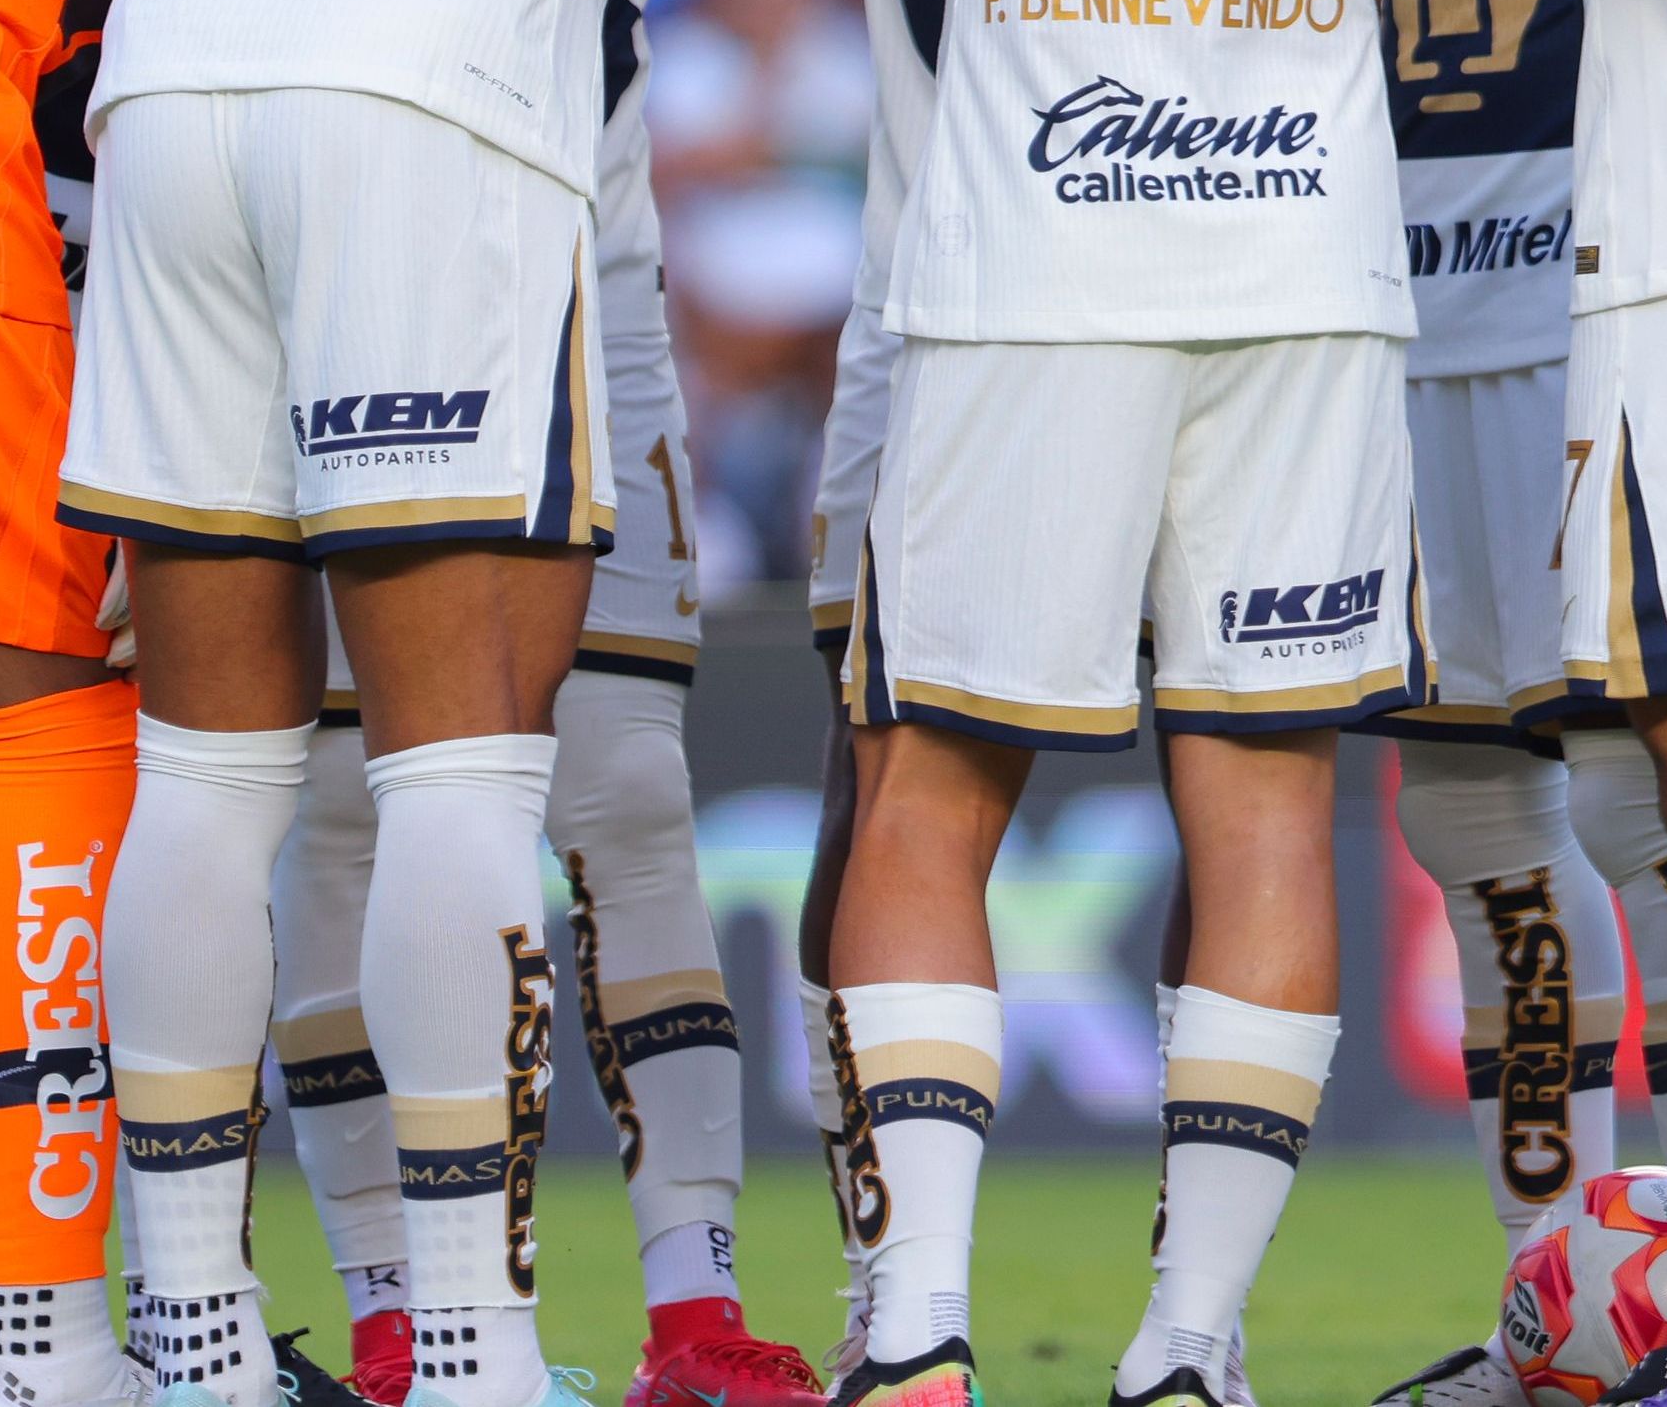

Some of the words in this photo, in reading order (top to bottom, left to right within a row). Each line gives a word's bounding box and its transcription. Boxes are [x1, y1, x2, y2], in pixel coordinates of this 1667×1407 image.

[1029, 75, 1320, 174] Caliente
[1056, 160, 1328, 204] caliente.mx
[1448, 209, 1572, 275] Mifel
[320, 449, 451, 473] AUTOPARTES
[17, 839, 108, 1221] CREST
[1172, 1114, 1308, 1157] PUMAS
